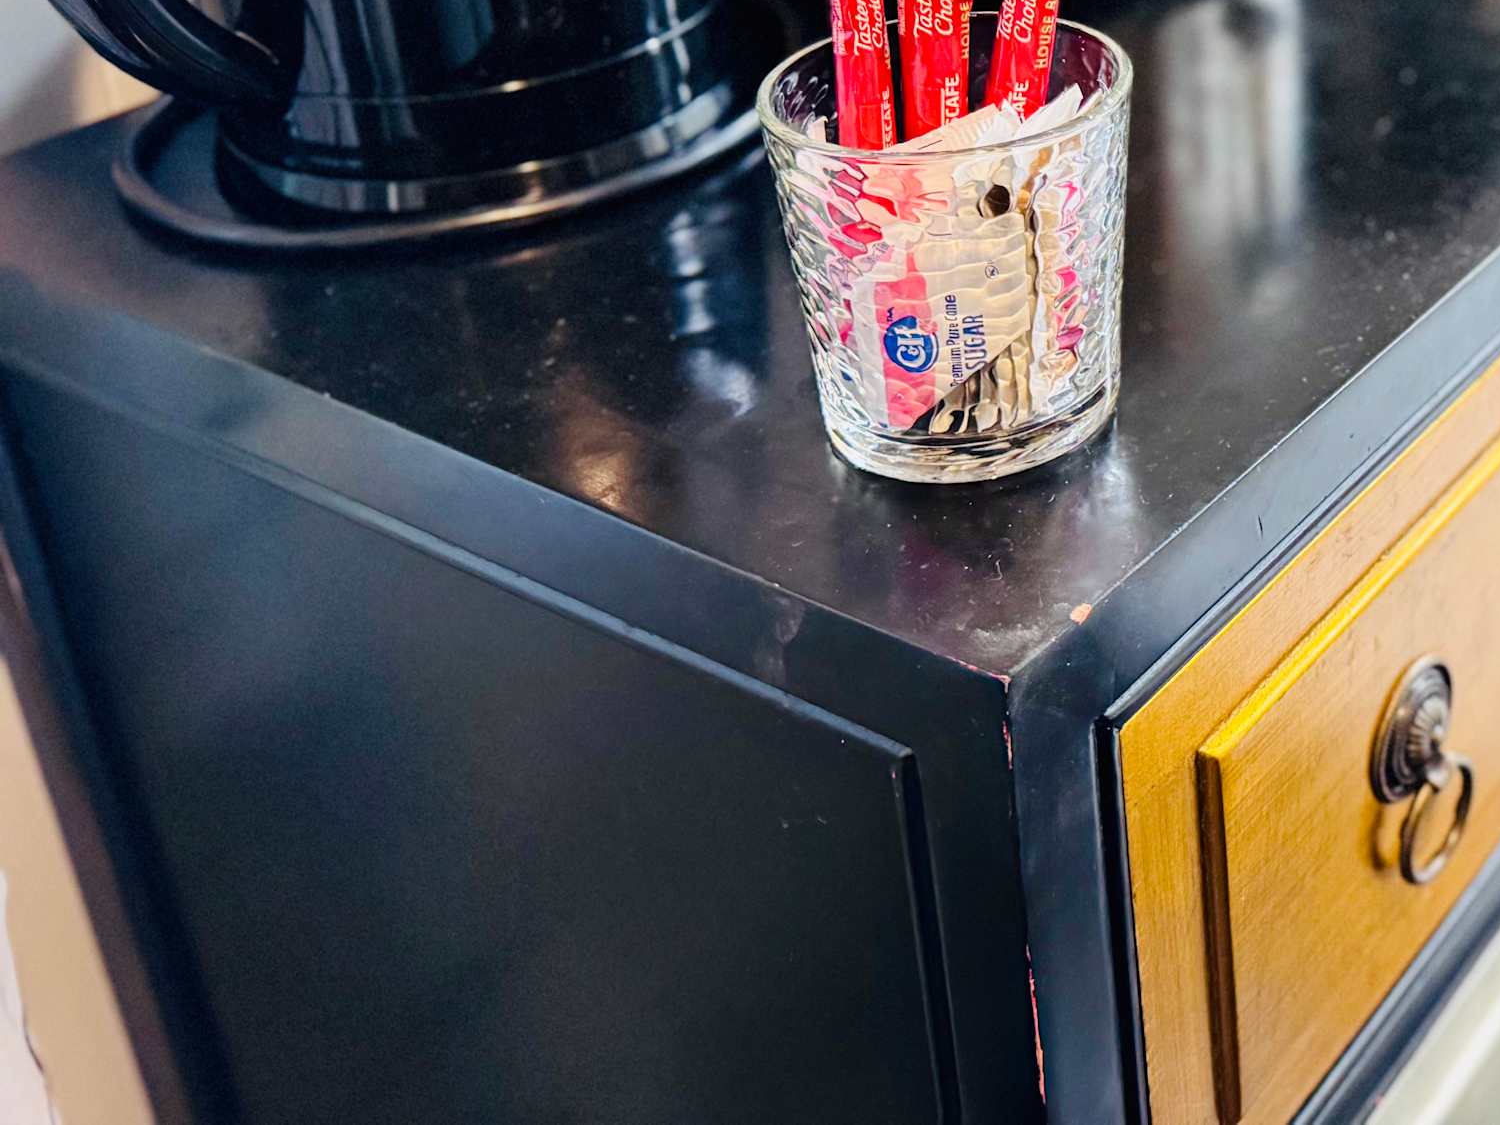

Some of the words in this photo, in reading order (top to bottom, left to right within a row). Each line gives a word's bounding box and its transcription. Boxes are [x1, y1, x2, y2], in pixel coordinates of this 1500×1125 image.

[1034, 16, 1052, 69] HOUSE
[946, 323, 959, 346] Pure
[962, 315, 987, 370] SUGAR
